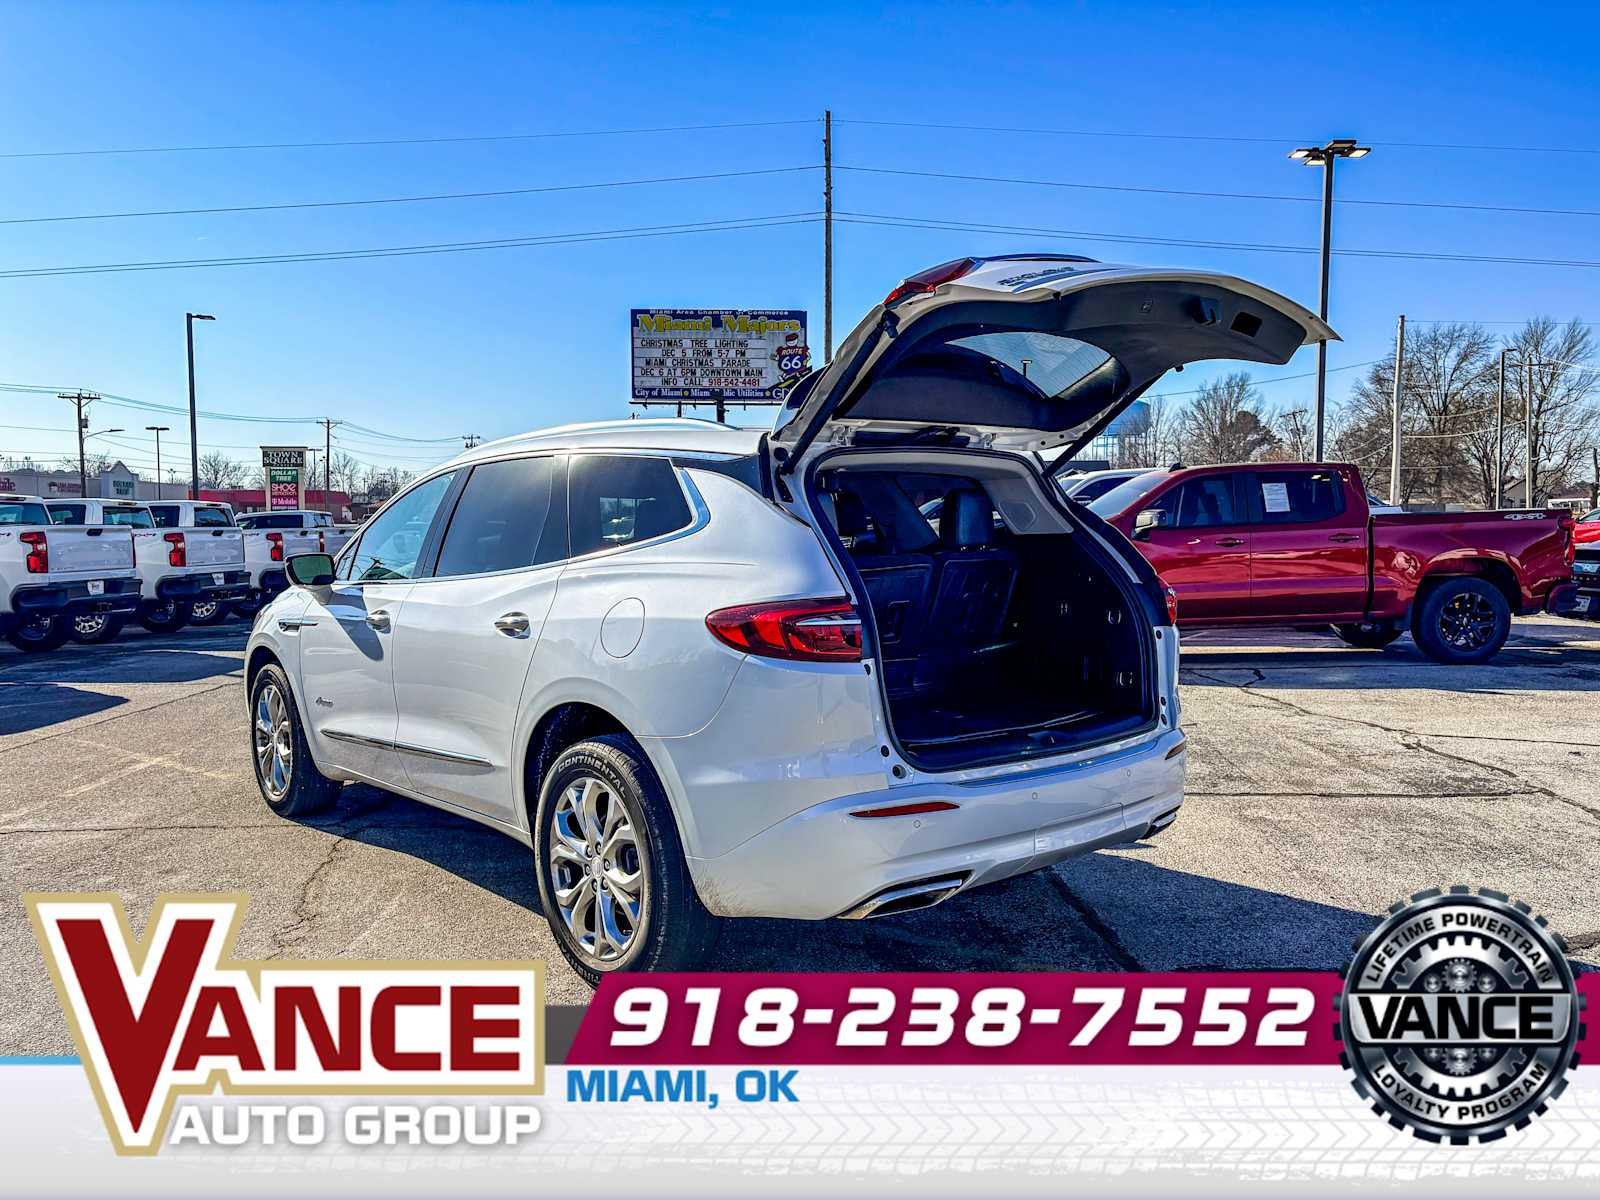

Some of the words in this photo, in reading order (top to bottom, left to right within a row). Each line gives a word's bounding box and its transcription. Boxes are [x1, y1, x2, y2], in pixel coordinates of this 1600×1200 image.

[638, 314, 712, 332] Miami
[721, 315, 801, 336] Majors
[640, 339, 684, 348] CHRISTMAS
[691, 340, 708, 348] TREE
[714, 340, 749, 348] LIGHTING
[661, 350, 676, 358] DEC
[692, 350, 713, 358] FROM
[717, 350, 730, 358] 5-7
[735, 350, 746, 358] PM
[645, 359, 667, 367] MIAMI
[671, 359, 715, 367] CHRISTMAS
[721, 359, 751, 368] PARADE
[781, 356, 802, 370] 66
[640, 368, 655, 377] DEC
[658, 368, 664, 377] 6
[667, 369, 678, 377] AT
[680, 368, 697, 377] 6PM
[700, 368, 742, 377] DOWNTOWN
[744, 369, 763, 377] MAIN
[708, 378, 760, 387] 918-542-4481
[634, 388, 650, 398] City
[651, 388, 659, 397] of
[661, 388, 683, 397] Miami
[737, 388, 764, 397] Utilities
[558, 755, 626, 799] CONTINENTAL
